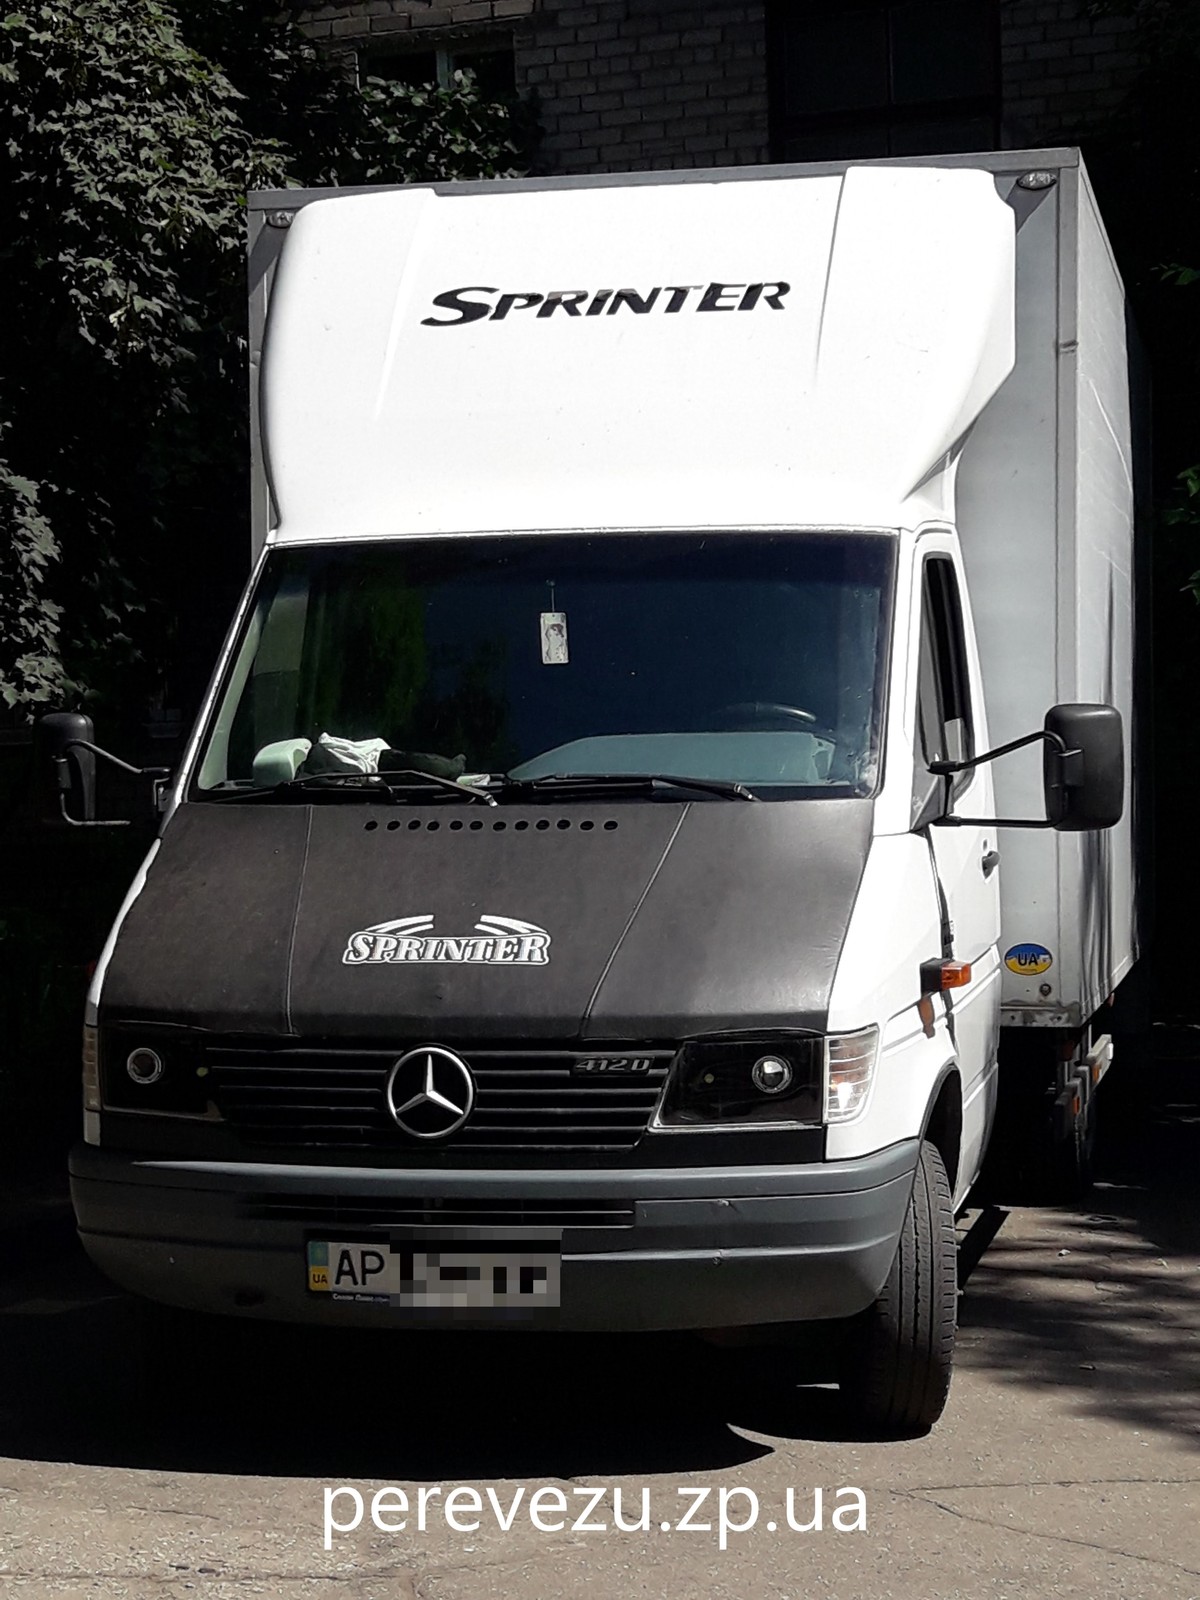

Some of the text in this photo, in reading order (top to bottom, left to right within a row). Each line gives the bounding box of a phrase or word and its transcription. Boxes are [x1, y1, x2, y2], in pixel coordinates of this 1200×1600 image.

[420, 282, 791, 326] SPRINTER
[346, 934, 547, 963] SPRINTER
[1017, 953, 1039, 966] UA
[312, 1273, 328, 1285] UA
[335, 1249, 385, 1286] AP
